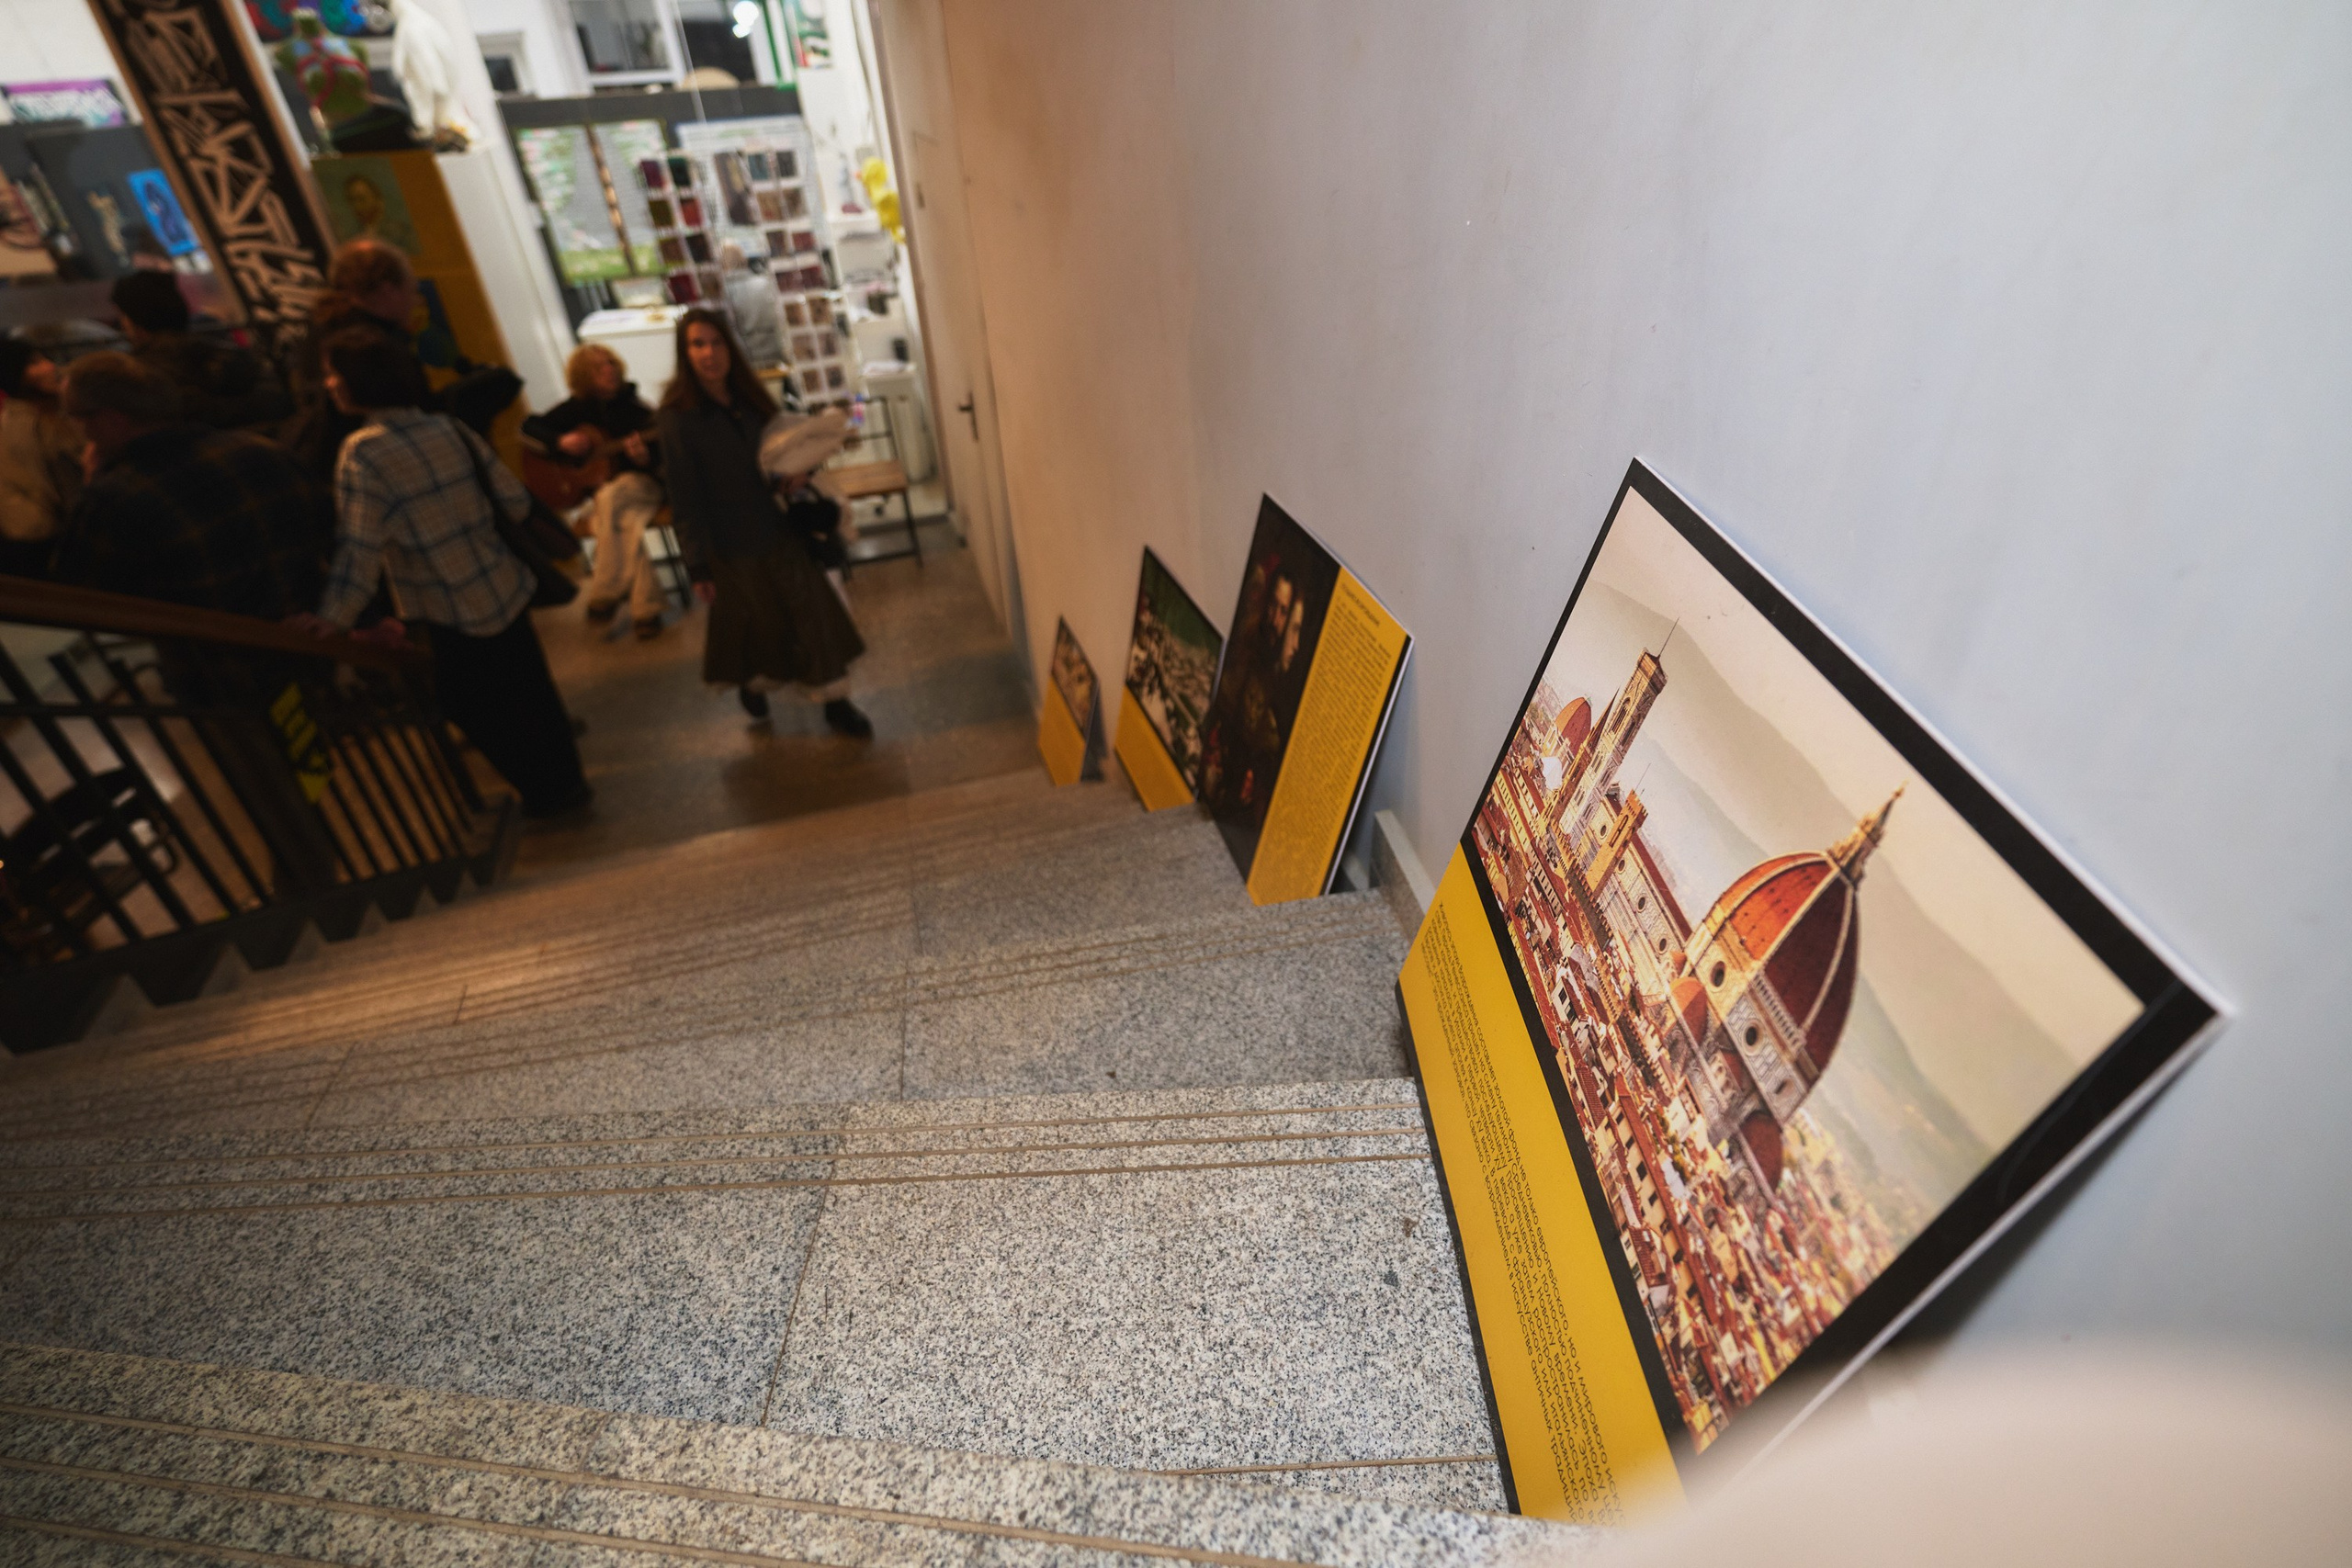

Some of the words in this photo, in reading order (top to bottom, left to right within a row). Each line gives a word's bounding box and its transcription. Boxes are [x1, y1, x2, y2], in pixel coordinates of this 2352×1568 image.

[1453, 1043, 1466, 1076] апогея
[1476, 1026, 1497, 1082] составляет
[1465, 1085, 1477, 1118] концу
[1475, 1117, 1484, 1134] XV
[1493, 1082, 1511, 1128] золотой
[1479, 1135, 1490, 1168] века.
[1505, 1126, 1521, 1167] фонд
[1518, 1164, 1527, 1183] не
[1492, 1178, 1511, 1242] переводе
[1522, 1182, 1539, 1226] только
[1453, 1018, 1466, 1053] Италии
[1465, 1064, 1482, 1102] первой
[1477, 1104, 1496, 1154] четверти
[1493, 1154, 1502, 1173] XV
[1498, 1176, 1510, 1211] века,
[1510, 1225, 1522, 1255] уже
[1520, 1258, 1535, 1304] затем
[1532, 1305, 1580, 1472] распространилась
[1577, 1474, 1589, 1504] по
[1454, 1000, 1480, 1076] предшествовал
[1476, 1078, 1508, 1169] последующему
[1504, 1169, 1534, 1269] Просвещению
[1535, 1284, 1555, 1349] Новому
[1553, 1350, 1577, 1436] времени.
[1577, 1436, 1600, 1504] Эпоха
[1463, 1100, 1472, 1119] что
[1468, 1119, 1484, 1163] связано
[1484, 1174, 1511, 1271] возрождением
[1510, 1280, 1533, 1358] искусстве
[1530, 1358, 1554, 1435] античных
[1465, 1017, 1482, 1056] пришел
[1478, 1057, 1487, 1072] на
[1483, 1072, 1498, 1110] смену
[1493, 1108, 1513, 1164] темному
[1510, 1161, 1542, 1274] Средневековью,
[1540, 1272, 1567, 1358] полностью
[1564, 1357, 1605, 1493] подчиненному
[1535, 1225, 1568, 1338] европейского,
[1510, 1254, 1544, 1365] французского
[1566, 1335, 1577, 1360] но
[1540, 1365, 1553, 1399] или
[1577, 1374, 1608, 1466] мирового
[1549, 1399, 1585, 1521] итальянского
